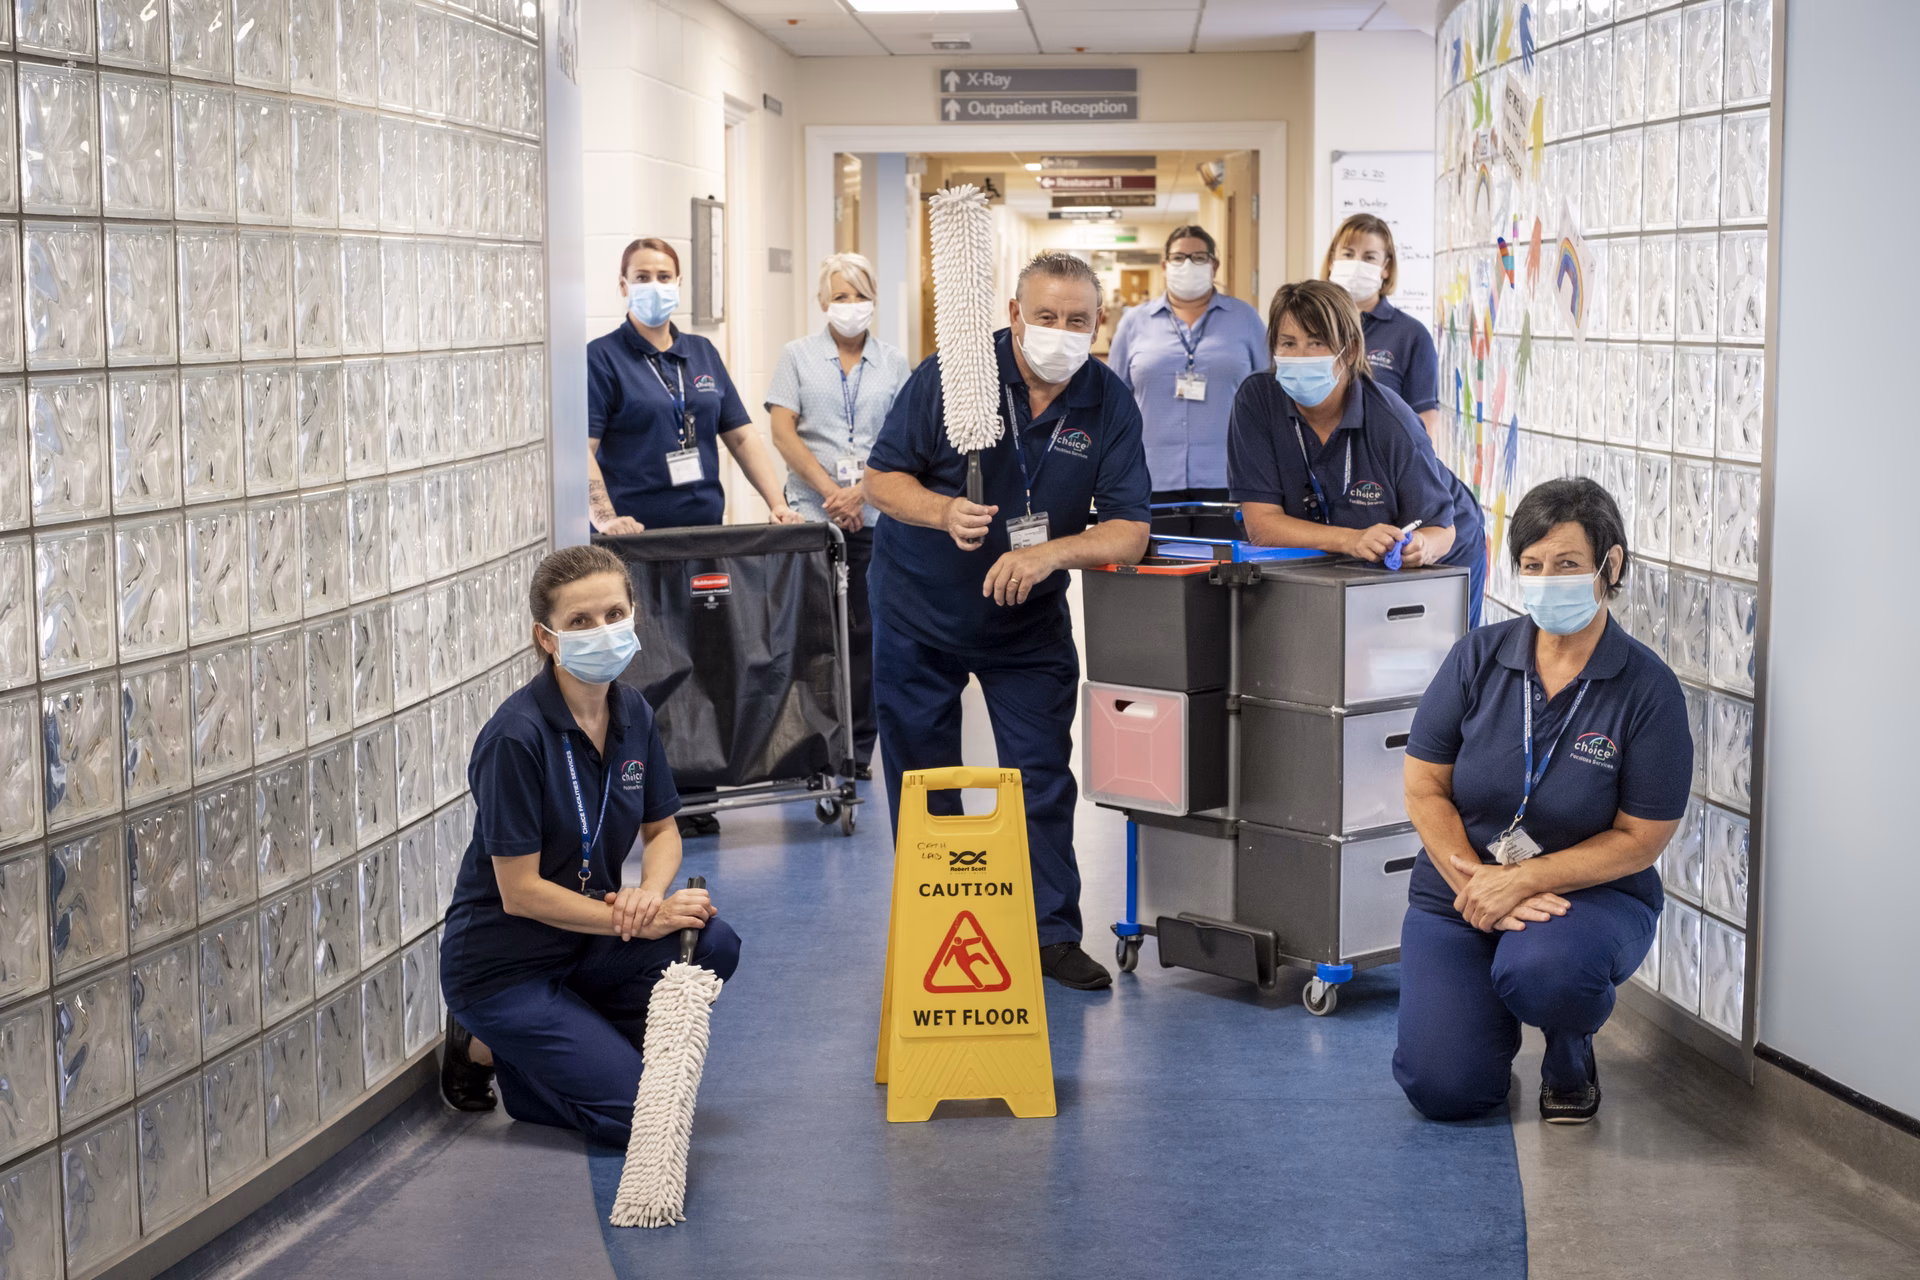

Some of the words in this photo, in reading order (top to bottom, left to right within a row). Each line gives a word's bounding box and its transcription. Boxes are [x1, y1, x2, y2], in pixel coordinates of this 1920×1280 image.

[967, 72, 1012, 90] X-Ray
[967, 100, 1048, 119] Outpatient
[1051, 99, 1127, 118] Reception
[1055, 177, 1110, 188] Restaurant
[1057, 436, 1087, 450] choice
[1350, 488, 1381, 499] choice
[693, 578, 728, 586] Rubbermaid
[1574, 741, 1611, 759] choice
[566, 750, 576, 780] SERVICES
[1570, 752, 1592, 764] Facilities
[1591, 759, 1614, 770] Services
[573, 780, 584, 812] FACILITIES
[917, 842, 947, 851] CATH
[919, 882, 1013, 897] CAUTION
[913, 1010, 957, 1026] WET
[962, 1008, 1029, 1025] FLOOR
